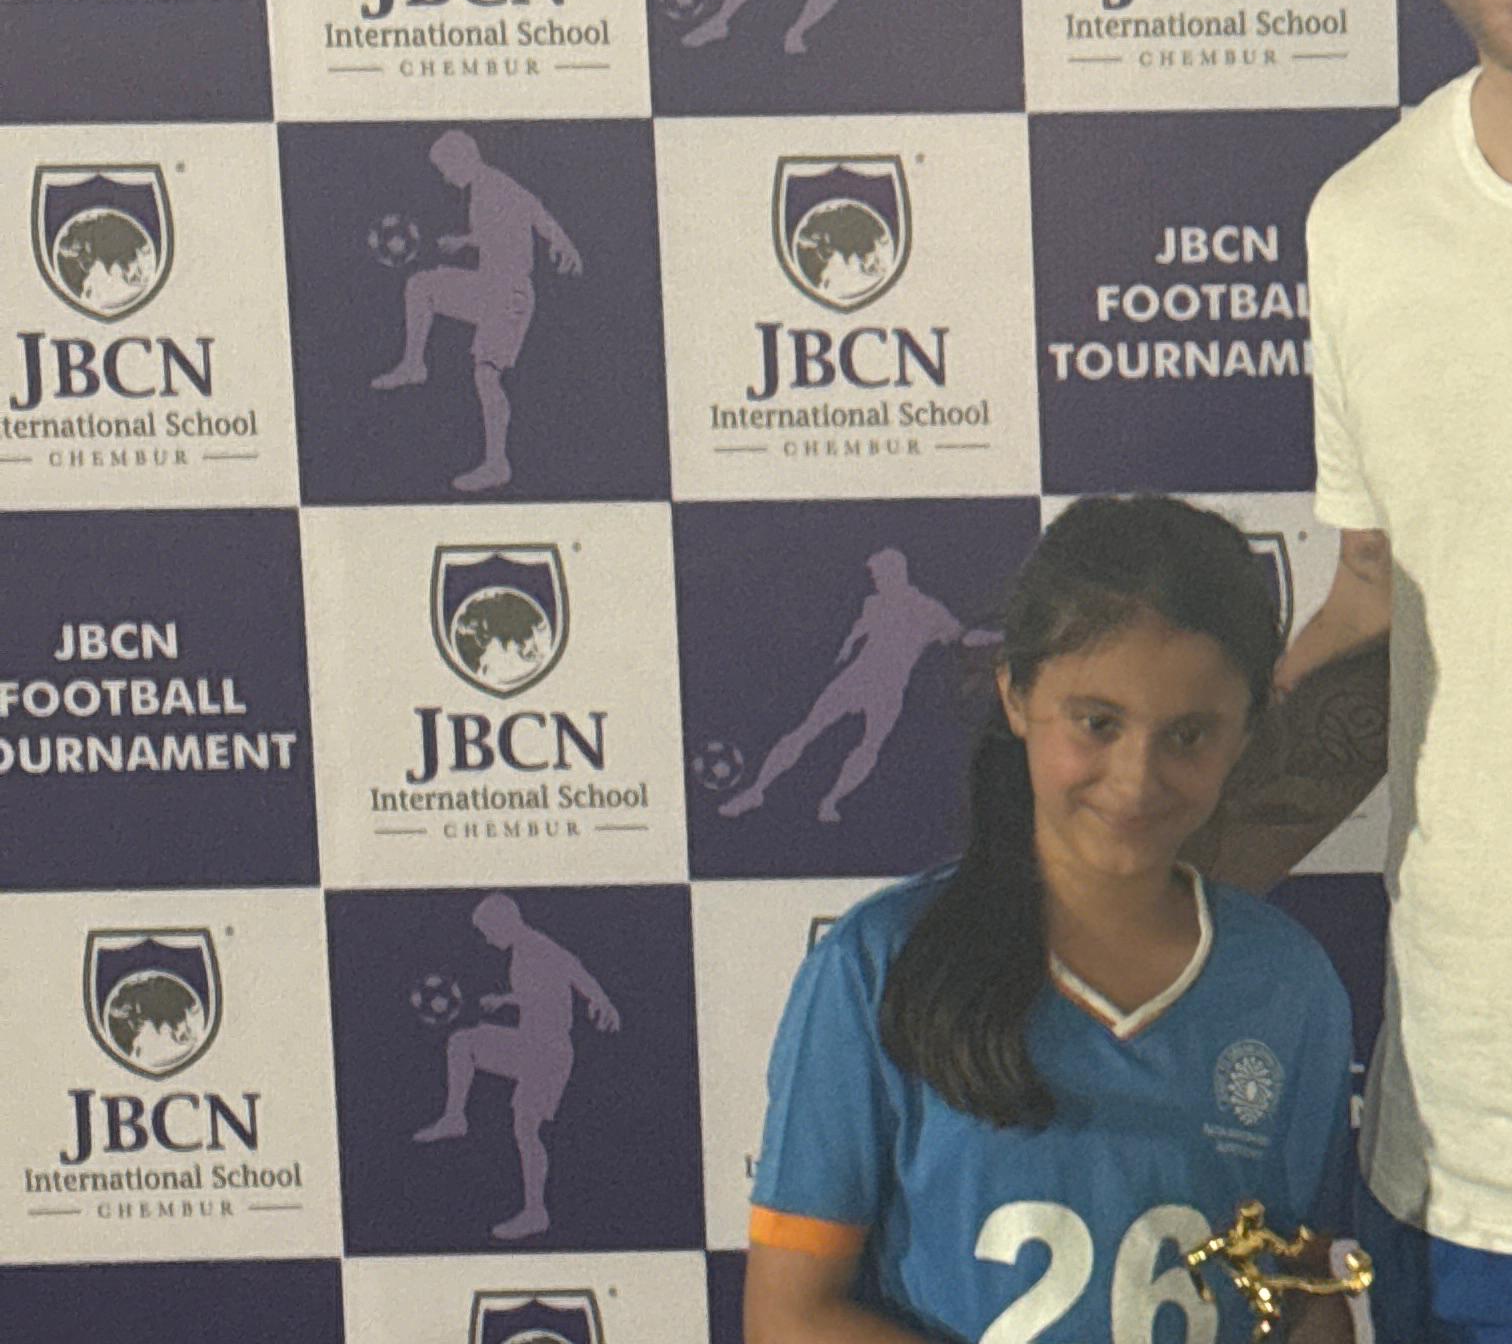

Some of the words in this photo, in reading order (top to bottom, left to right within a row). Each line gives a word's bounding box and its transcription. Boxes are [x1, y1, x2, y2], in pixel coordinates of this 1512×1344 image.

[325, 19, 508, 48] International
[517, 19, 610, 46] School
[1066, 10, 1246, 39] International
[1256, 8, 1347, 36] School
[1156, 226, 1278, 263] JBCN
[1097, 283, 1311, 323] FOOTBAL
[10, 337, 214, 411] JBCN
[747, 324, 949, 401] JBCN
[1048, 341, 1313, 380] TOURNAM
[166, 410, 257, 437] School
[711, 401, 890, 429] International
[899, 400, 989, 427] School
[55, 623, 177, 660] JBCN
[0, 679, 246, 717] FOOTBALL
[406, 707, 607, 783] JBCN
[371, 783, 549, 811] International
[558, 782, 648, 809] School
[60, 1089, 260, 1164] JBCN
[25, 1164, 202, 1192] International
[212, 1162, 302, 1189] School
